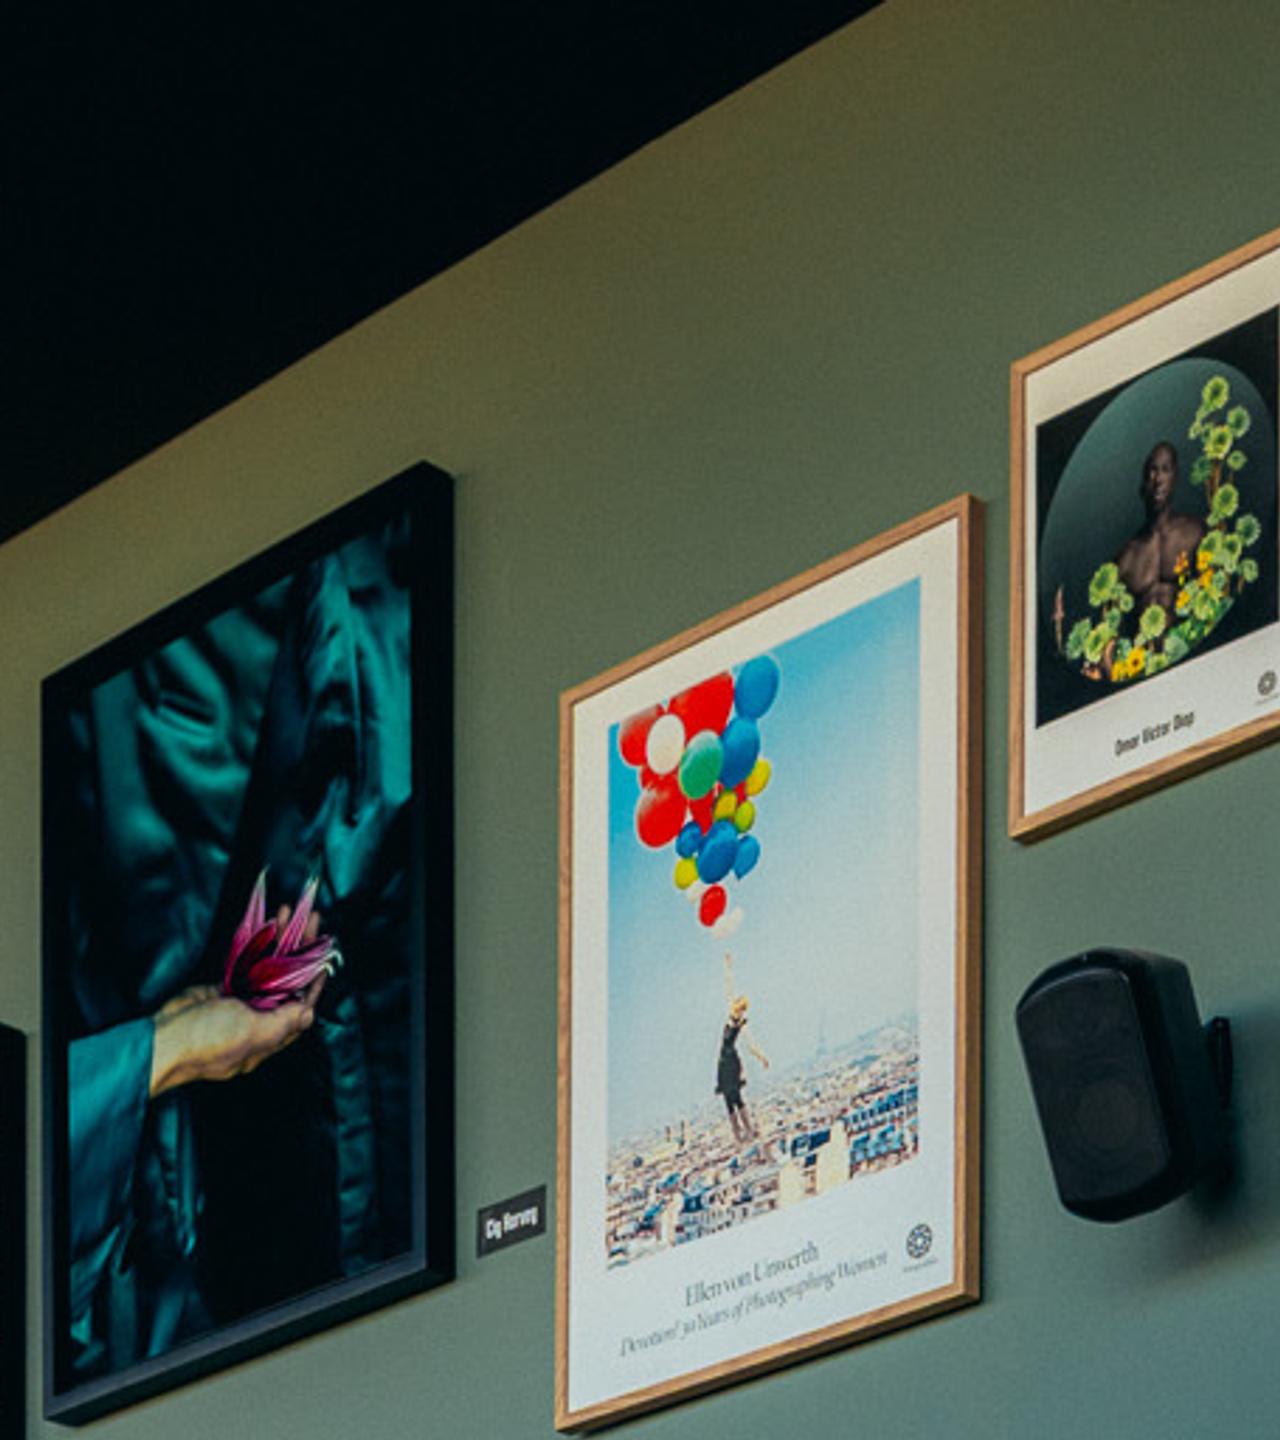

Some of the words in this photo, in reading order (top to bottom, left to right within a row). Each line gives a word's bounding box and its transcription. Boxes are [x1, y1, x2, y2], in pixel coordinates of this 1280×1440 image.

[1114, 733, 1140, 757] Omar
[1142, 721, 1171, 744] Victor
[684, 1279, 721, 1307] Ellen
[722, 1270, 752, 1294] von
